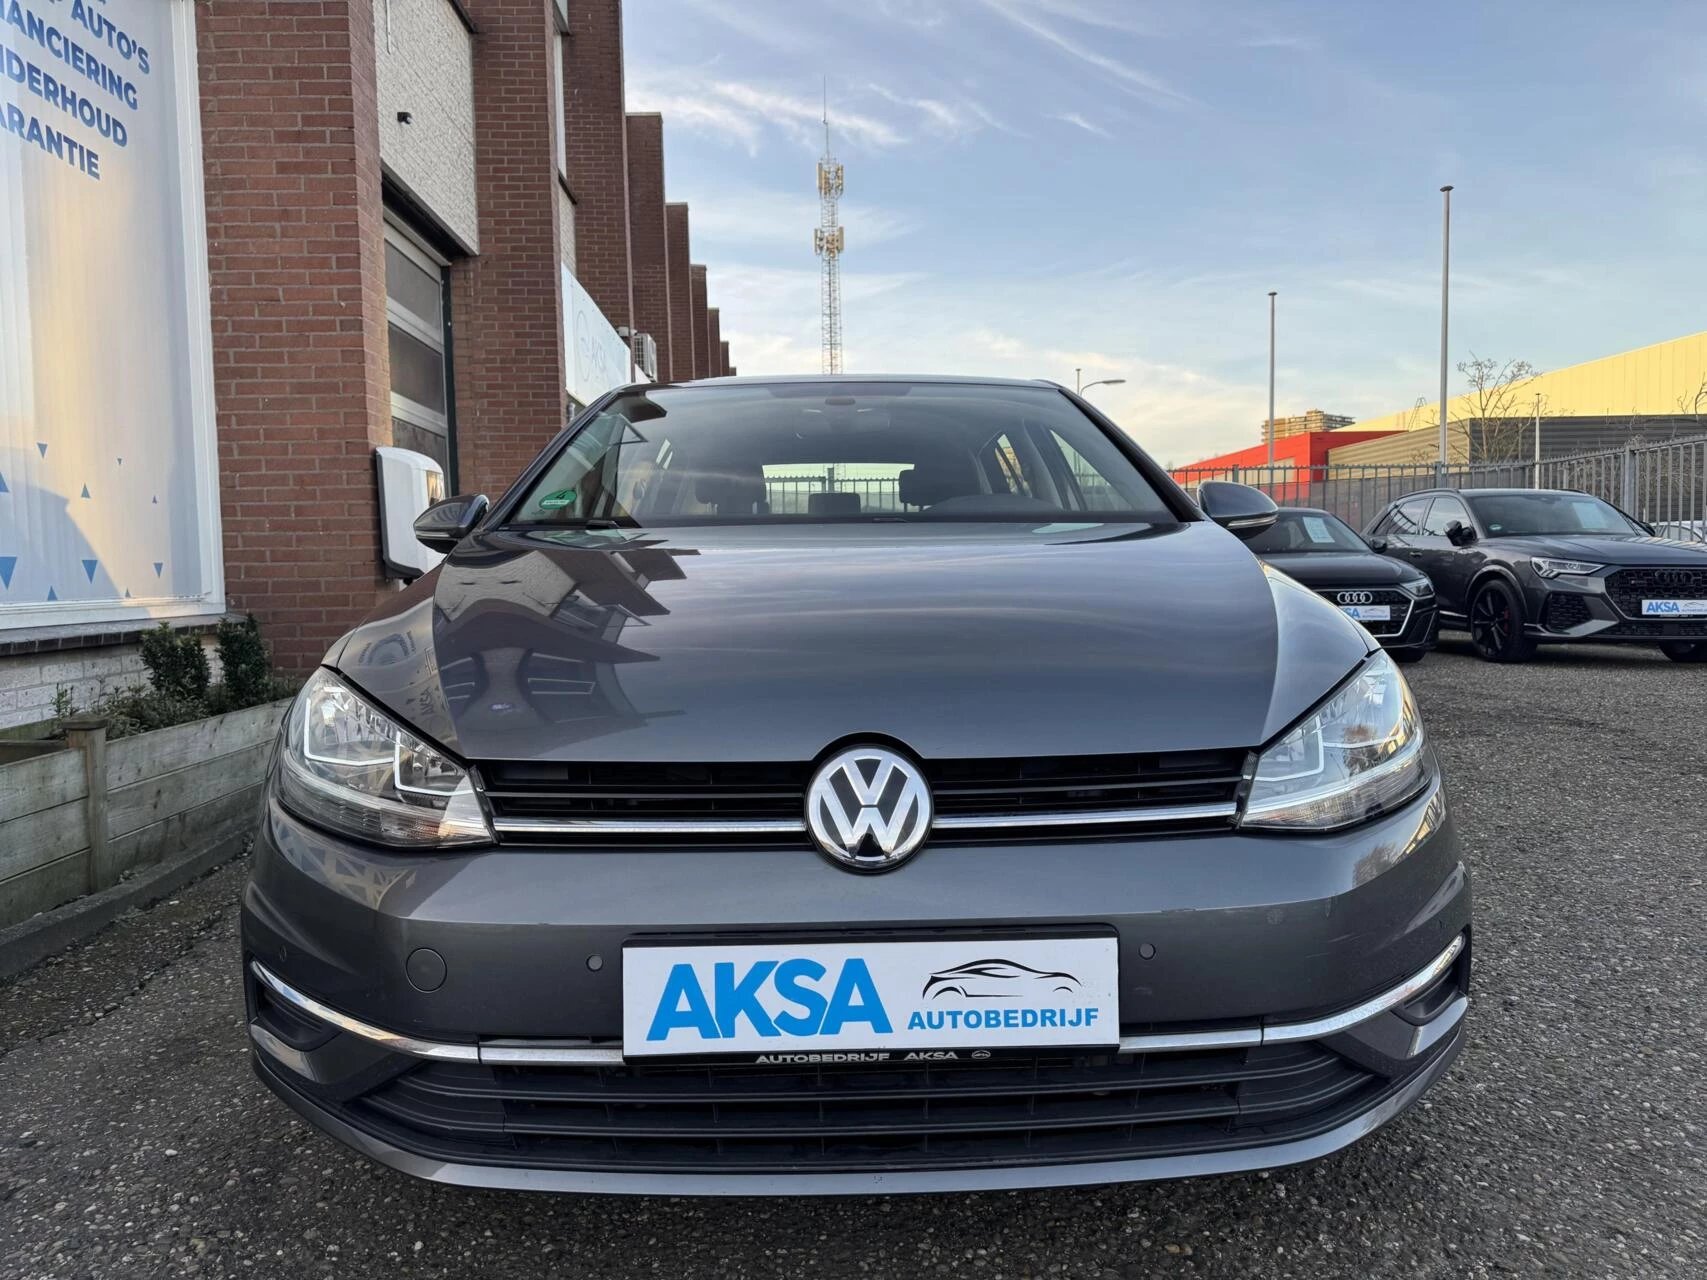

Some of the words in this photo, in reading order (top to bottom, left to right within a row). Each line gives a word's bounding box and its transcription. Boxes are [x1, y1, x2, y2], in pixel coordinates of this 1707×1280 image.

[0, 0, 138, 111] ANCIERING
[71, 0, 150, 75] AUTO'S
[0, 43, 128, 148] DERHOUD
[1646, 601, 1680, 613] AKSA
[646, 958, 893, 1041] AKSA
[907, 1007, 1099, 1030] AUTOBEDRIJF
[755, 1052, 891, 1064] AUTOBEDRIJF
[904, 1050, 959, 1062] AKSA
